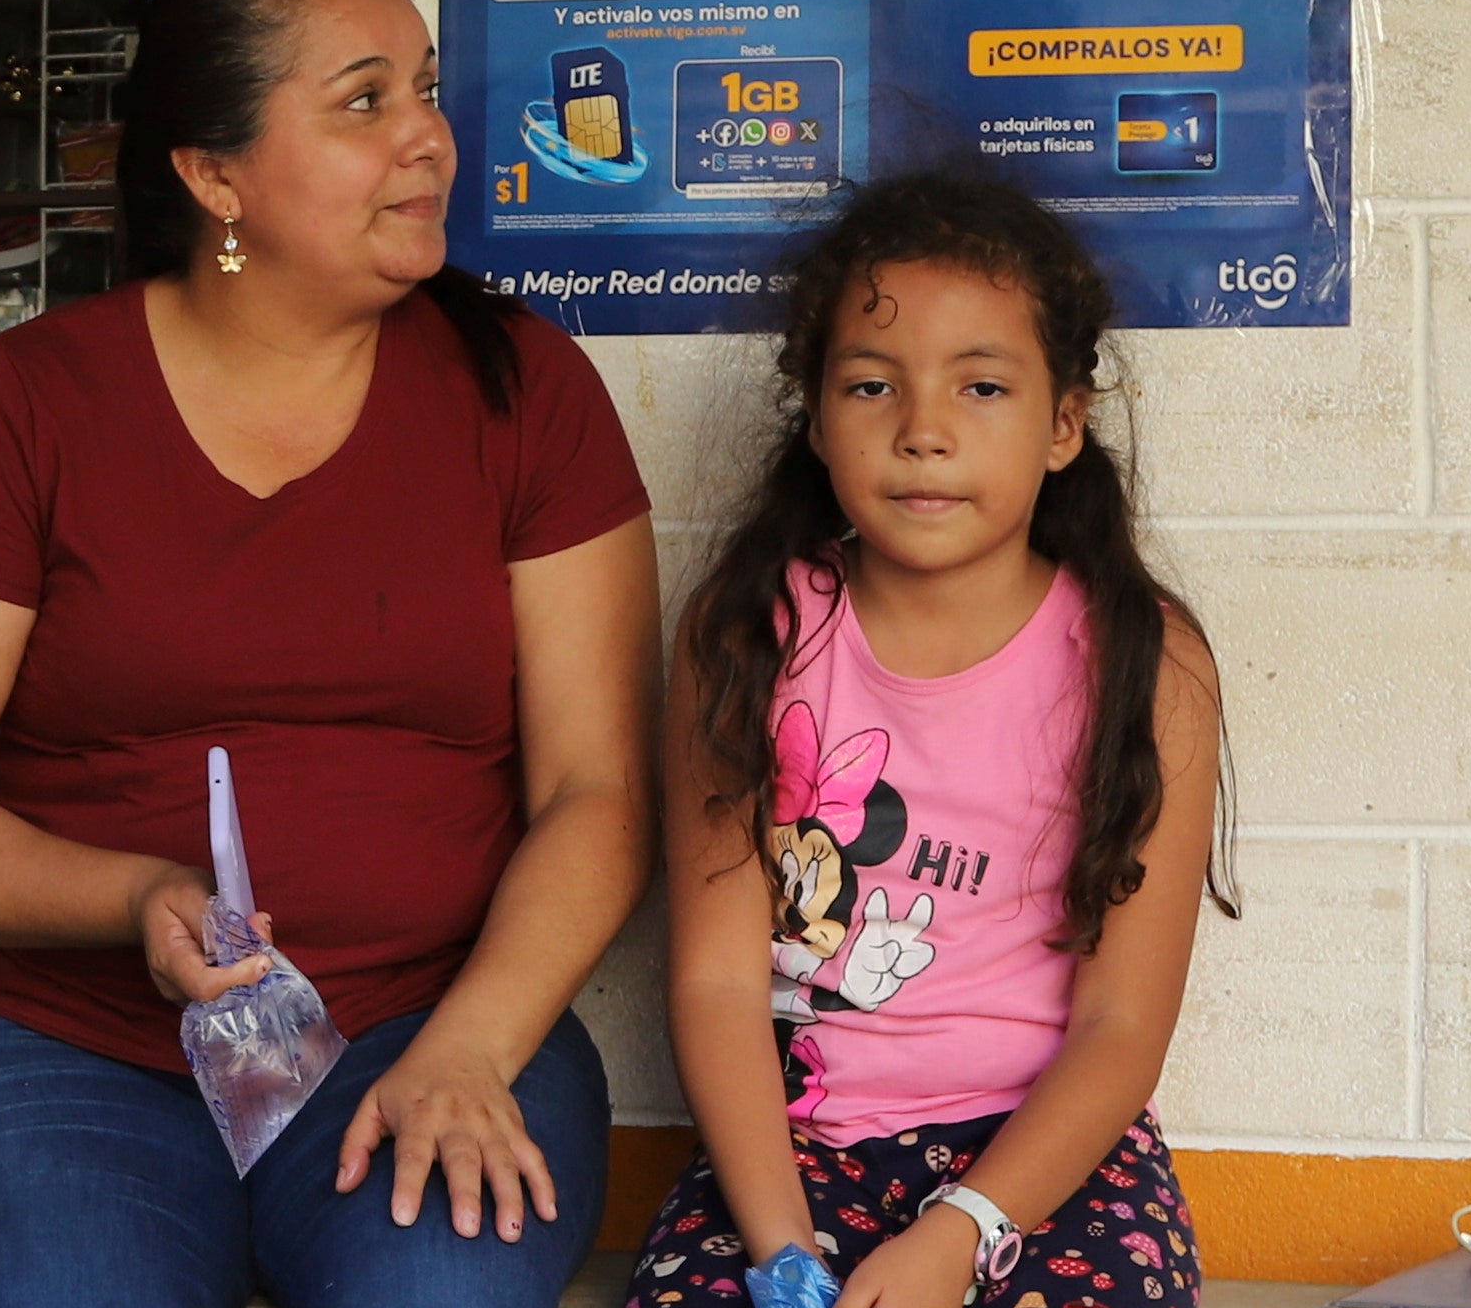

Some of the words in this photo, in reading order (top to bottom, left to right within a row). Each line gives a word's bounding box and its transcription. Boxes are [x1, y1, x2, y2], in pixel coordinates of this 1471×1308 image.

[554, 7, 568, 25] Y
[572, 5, 653, 25] activalo
[658, 7, 694, 23] vos
[699, 4, 770, 21] mismo
[774, 5, 801, 20] en
[988, 38, 1170, 67] ¡COMPRALOS
[1179, 36, 1223, 58] YA!
[569, 62, 603, 89] LTE
[721, 72, 801, 113] 1GB
[980, 120, 991, 133] o
[993, 116, 1071, 136] adquirilos
[1074, 118, 1095, 132] en
[980, 137, 1041, 157] tarjetas
[1043, 135, 1095, 154] físicas
[494, 164, 510, 174] Por
[521, 270, 604, 301] Mejor
[608, 270, 662, 296] Red
[668, 268, 763, 295] donde
[1218, 254, 1297, 298] tigo
[907, 834, 990, 896] Hi!
